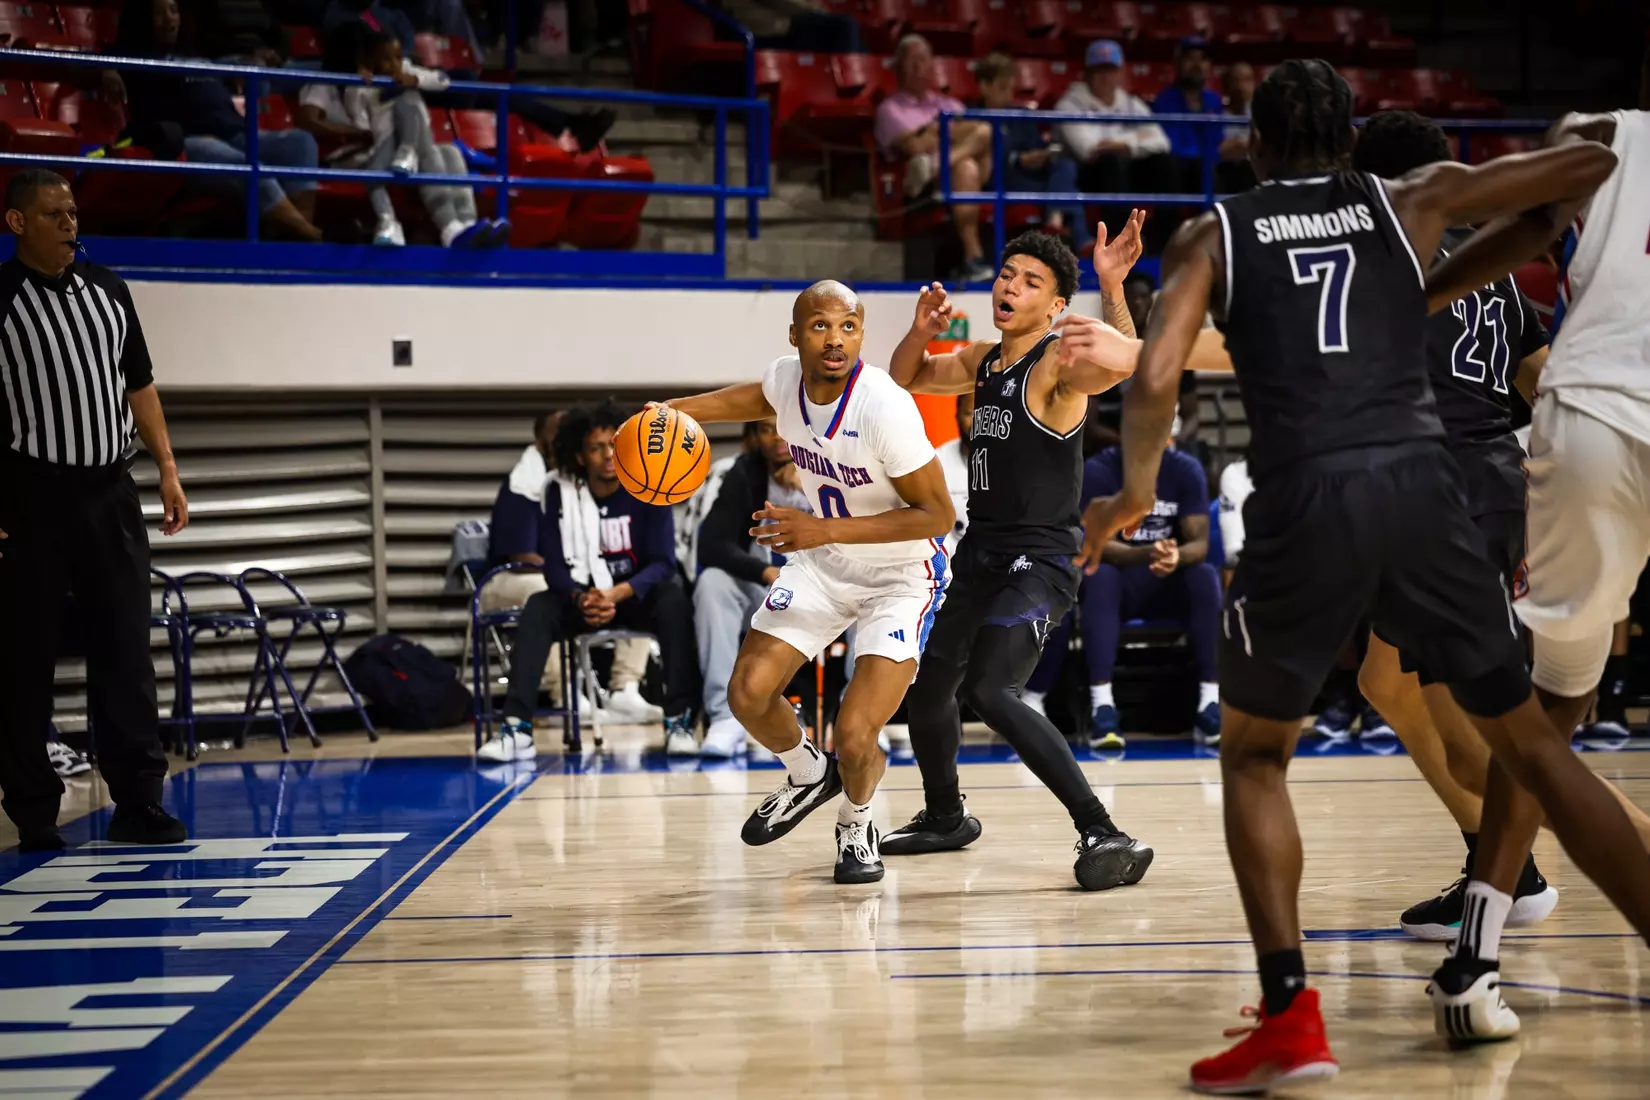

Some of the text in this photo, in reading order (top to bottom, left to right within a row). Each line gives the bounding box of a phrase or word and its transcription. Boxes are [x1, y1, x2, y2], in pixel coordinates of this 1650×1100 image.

[1254, 203, 1375, 244] SIMMONS
[1287, 243, 1356, 353] 7
[1451, 289, 1509, 395] 21
[837, 462, 874, 488] TECH
[971, 448, 989, 490] 11
[817, 484, 853, 518] 0
